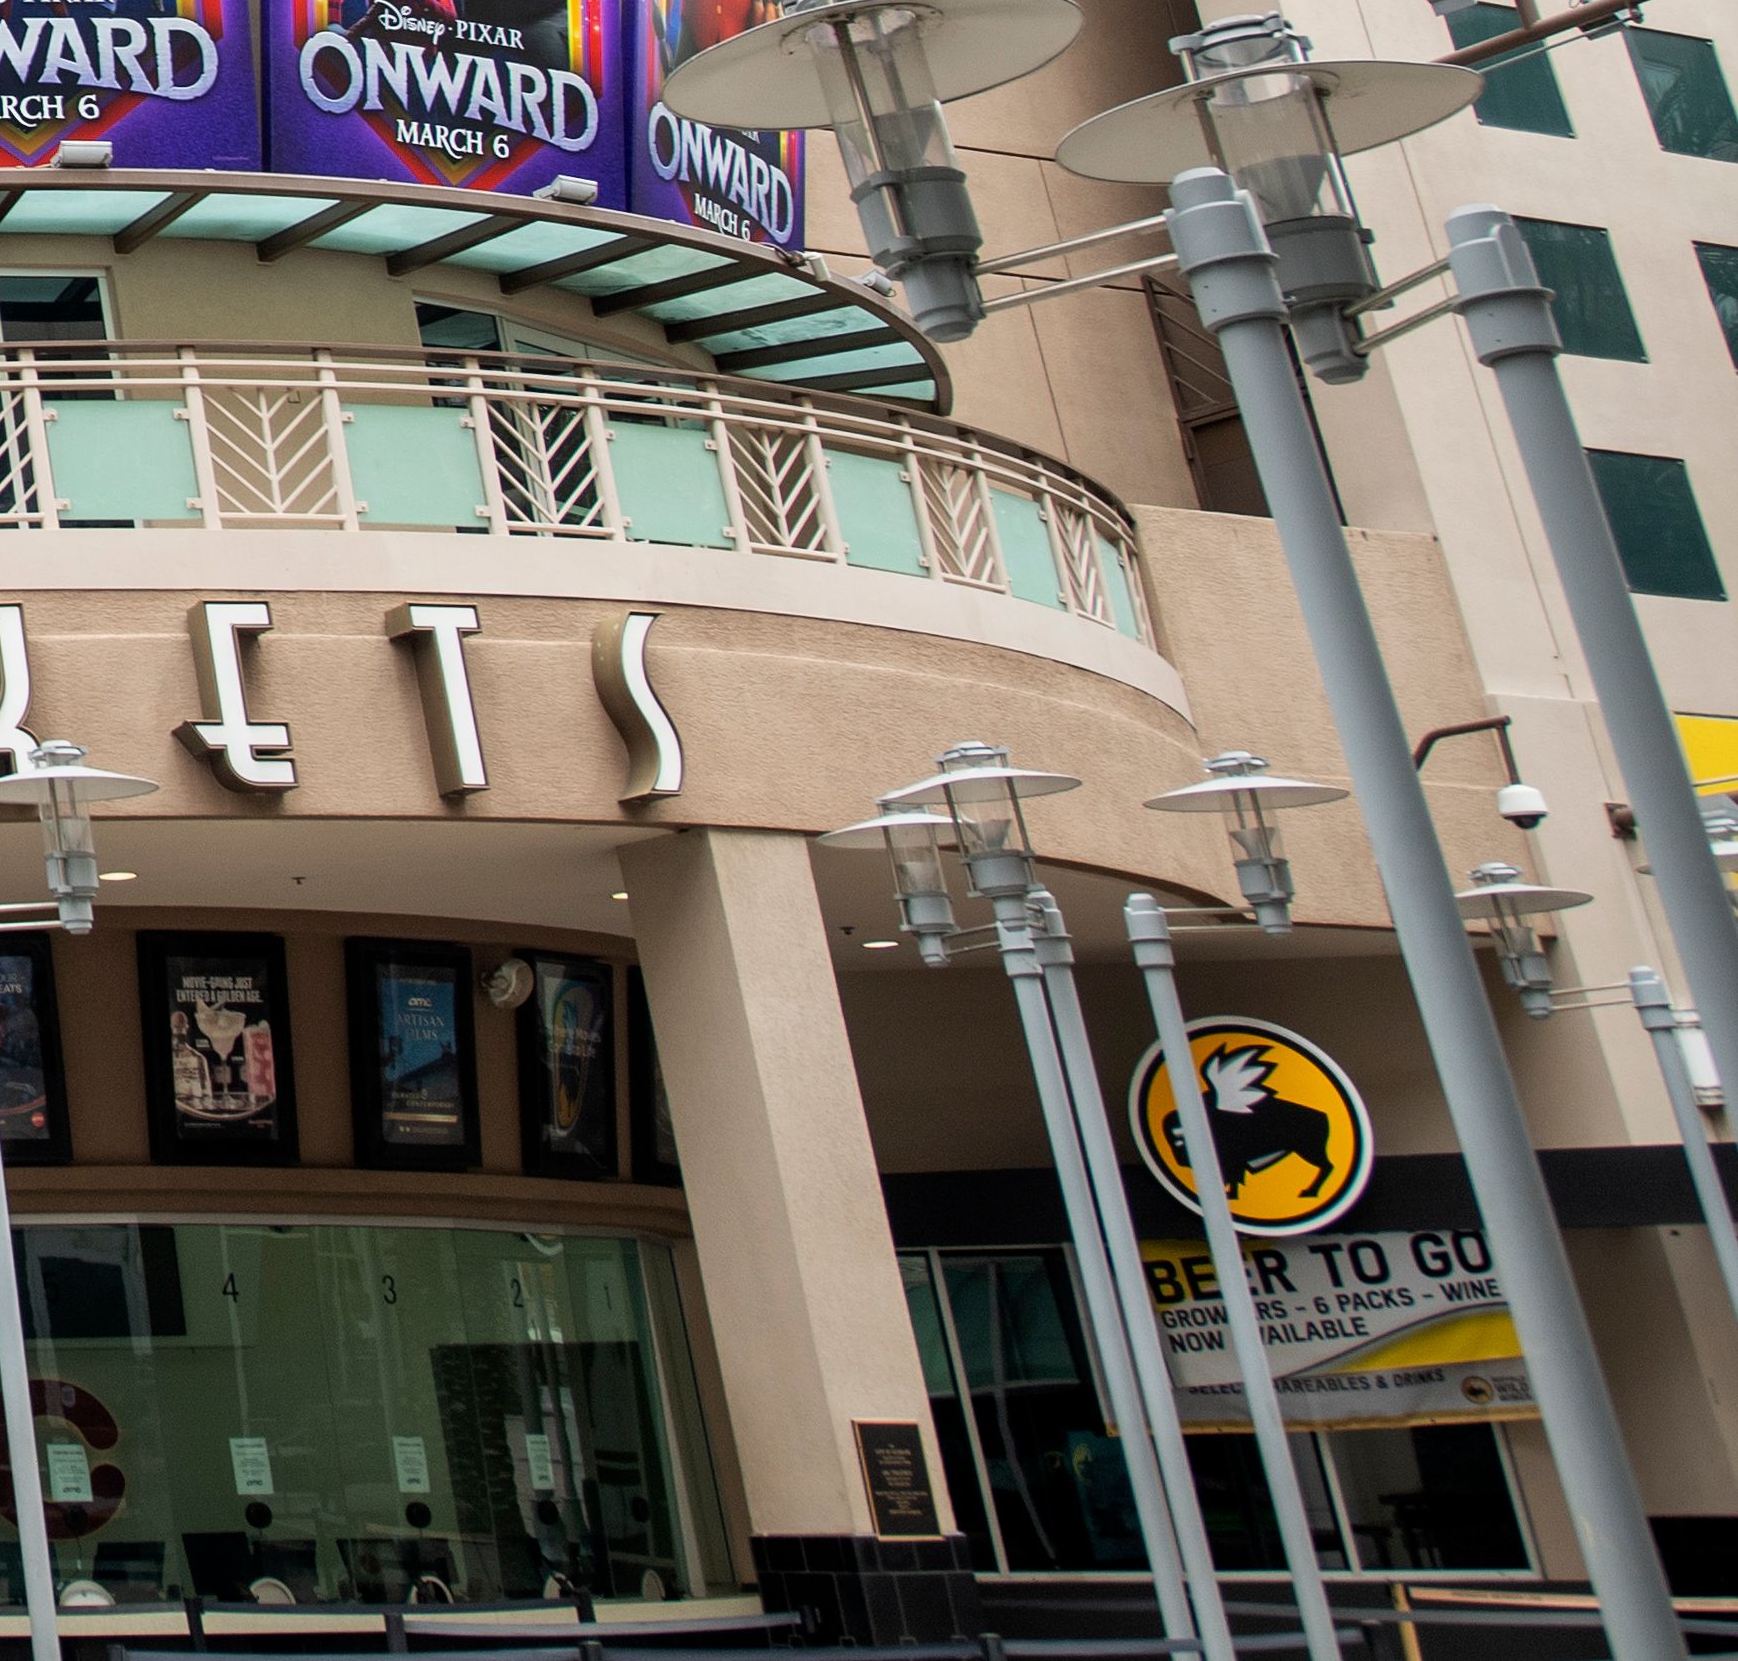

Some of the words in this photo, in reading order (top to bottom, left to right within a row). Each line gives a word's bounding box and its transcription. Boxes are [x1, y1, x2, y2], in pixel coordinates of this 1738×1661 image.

[455, 20, 524, 50] PIXAR
[78, 94, 100, 120] 6
[299, 31, 599, 152] ONWARD
[396, 118, 484, 159] MARCH
[493, 135, 510, 159] 6
[649, 101, 793, 244] ONWARD
[694, 193, 738, 235] MARCH
[741, 219, 751, 242] 6
[397, 1014, 445, 1027] ARTISAN
[1144, 1249, 1297, 1304] BER
[1309, 1239, 1390, 1288] TO
[1409, 1230, 1493, 1278] GO
[222, 1271, 239, 1304] 4
[381, 1275, 397, 1305] 3
[512, 1278, 524, 1308] 2
[1161, 1301, 1288, 1328] GROWRS
[1313, 1296, 1329, 1314] 6
[1336, 1288, 1414, 1314] PACKS
[1440, 1278, 1502, 1302] WINE
[1167, 1330, 1225, 1353] NOW
[1259, 1317, 1369, 1345] AILABLE
[1188, 1382, 1245, 1394] SELEC
[1393, 1368, 1446, 1387] DRINKS
